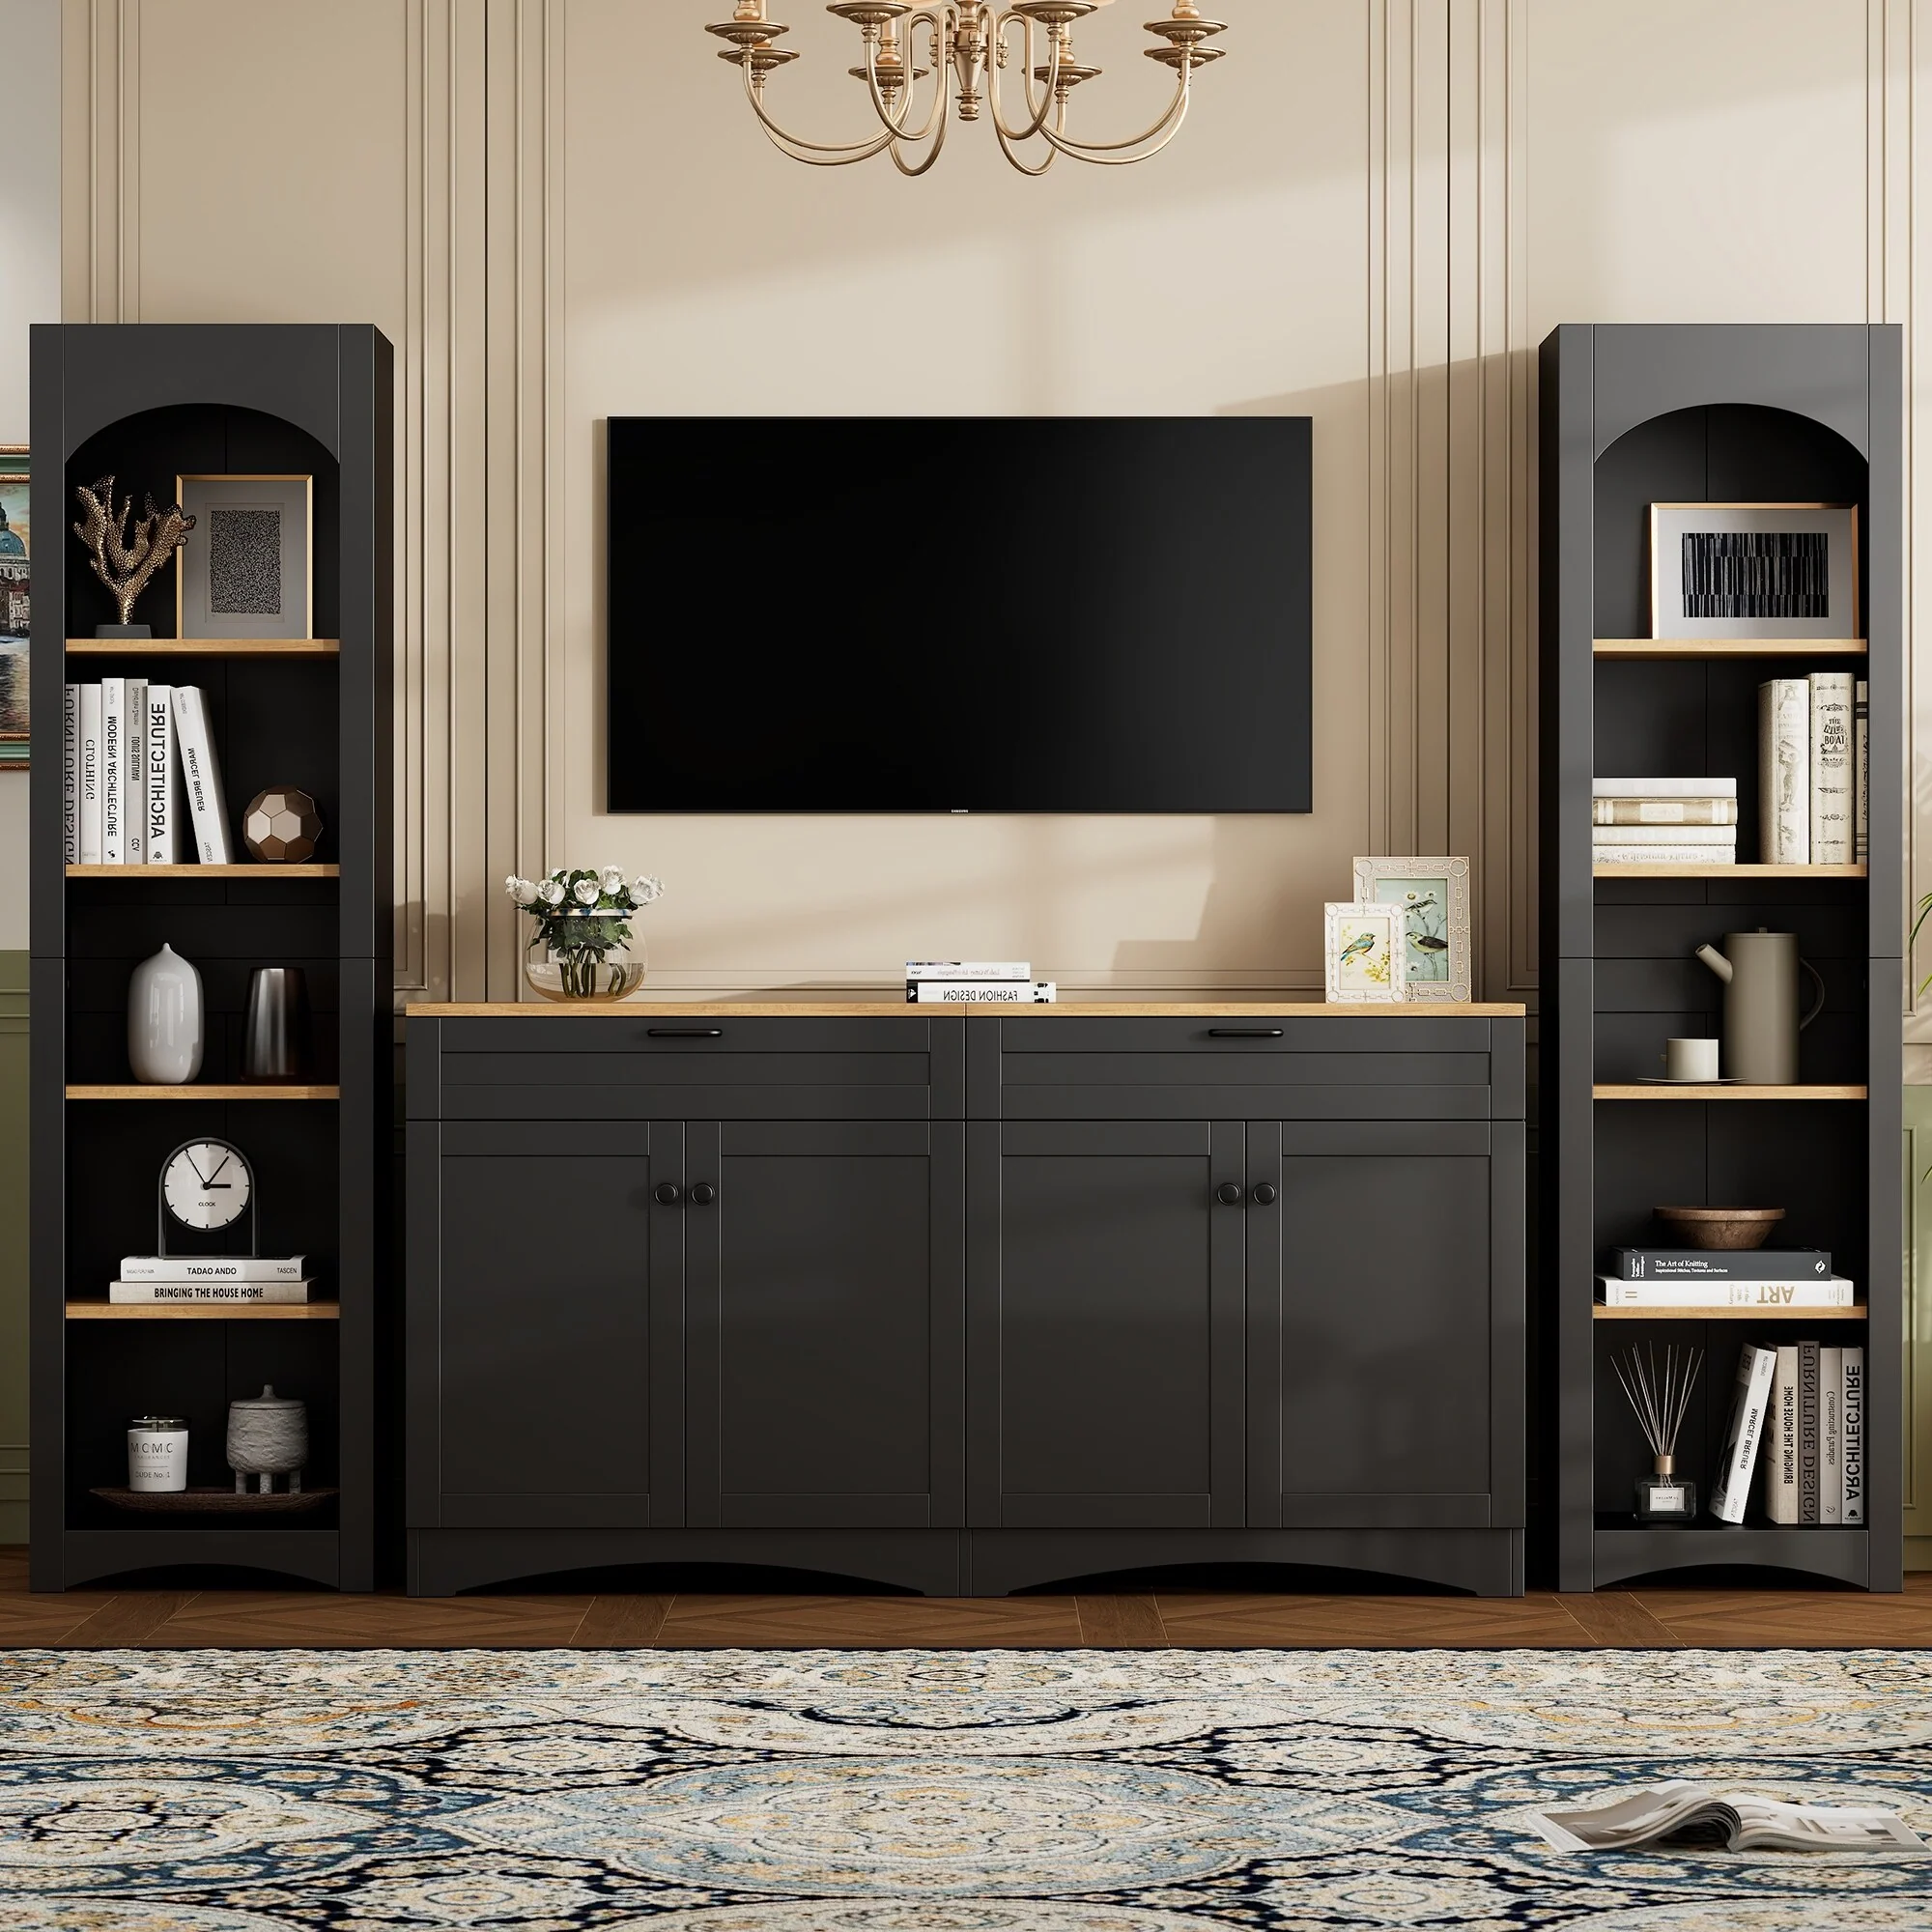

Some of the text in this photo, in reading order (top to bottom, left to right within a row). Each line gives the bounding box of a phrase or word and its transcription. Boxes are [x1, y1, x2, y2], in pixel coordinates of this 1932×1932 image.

[1685, 1260, 1709, 1269] Knitting
[154, 1288, 264, 1298] BRINGING THE HOUSE HOME
[1756, 1286, 1795, 1304] ART
